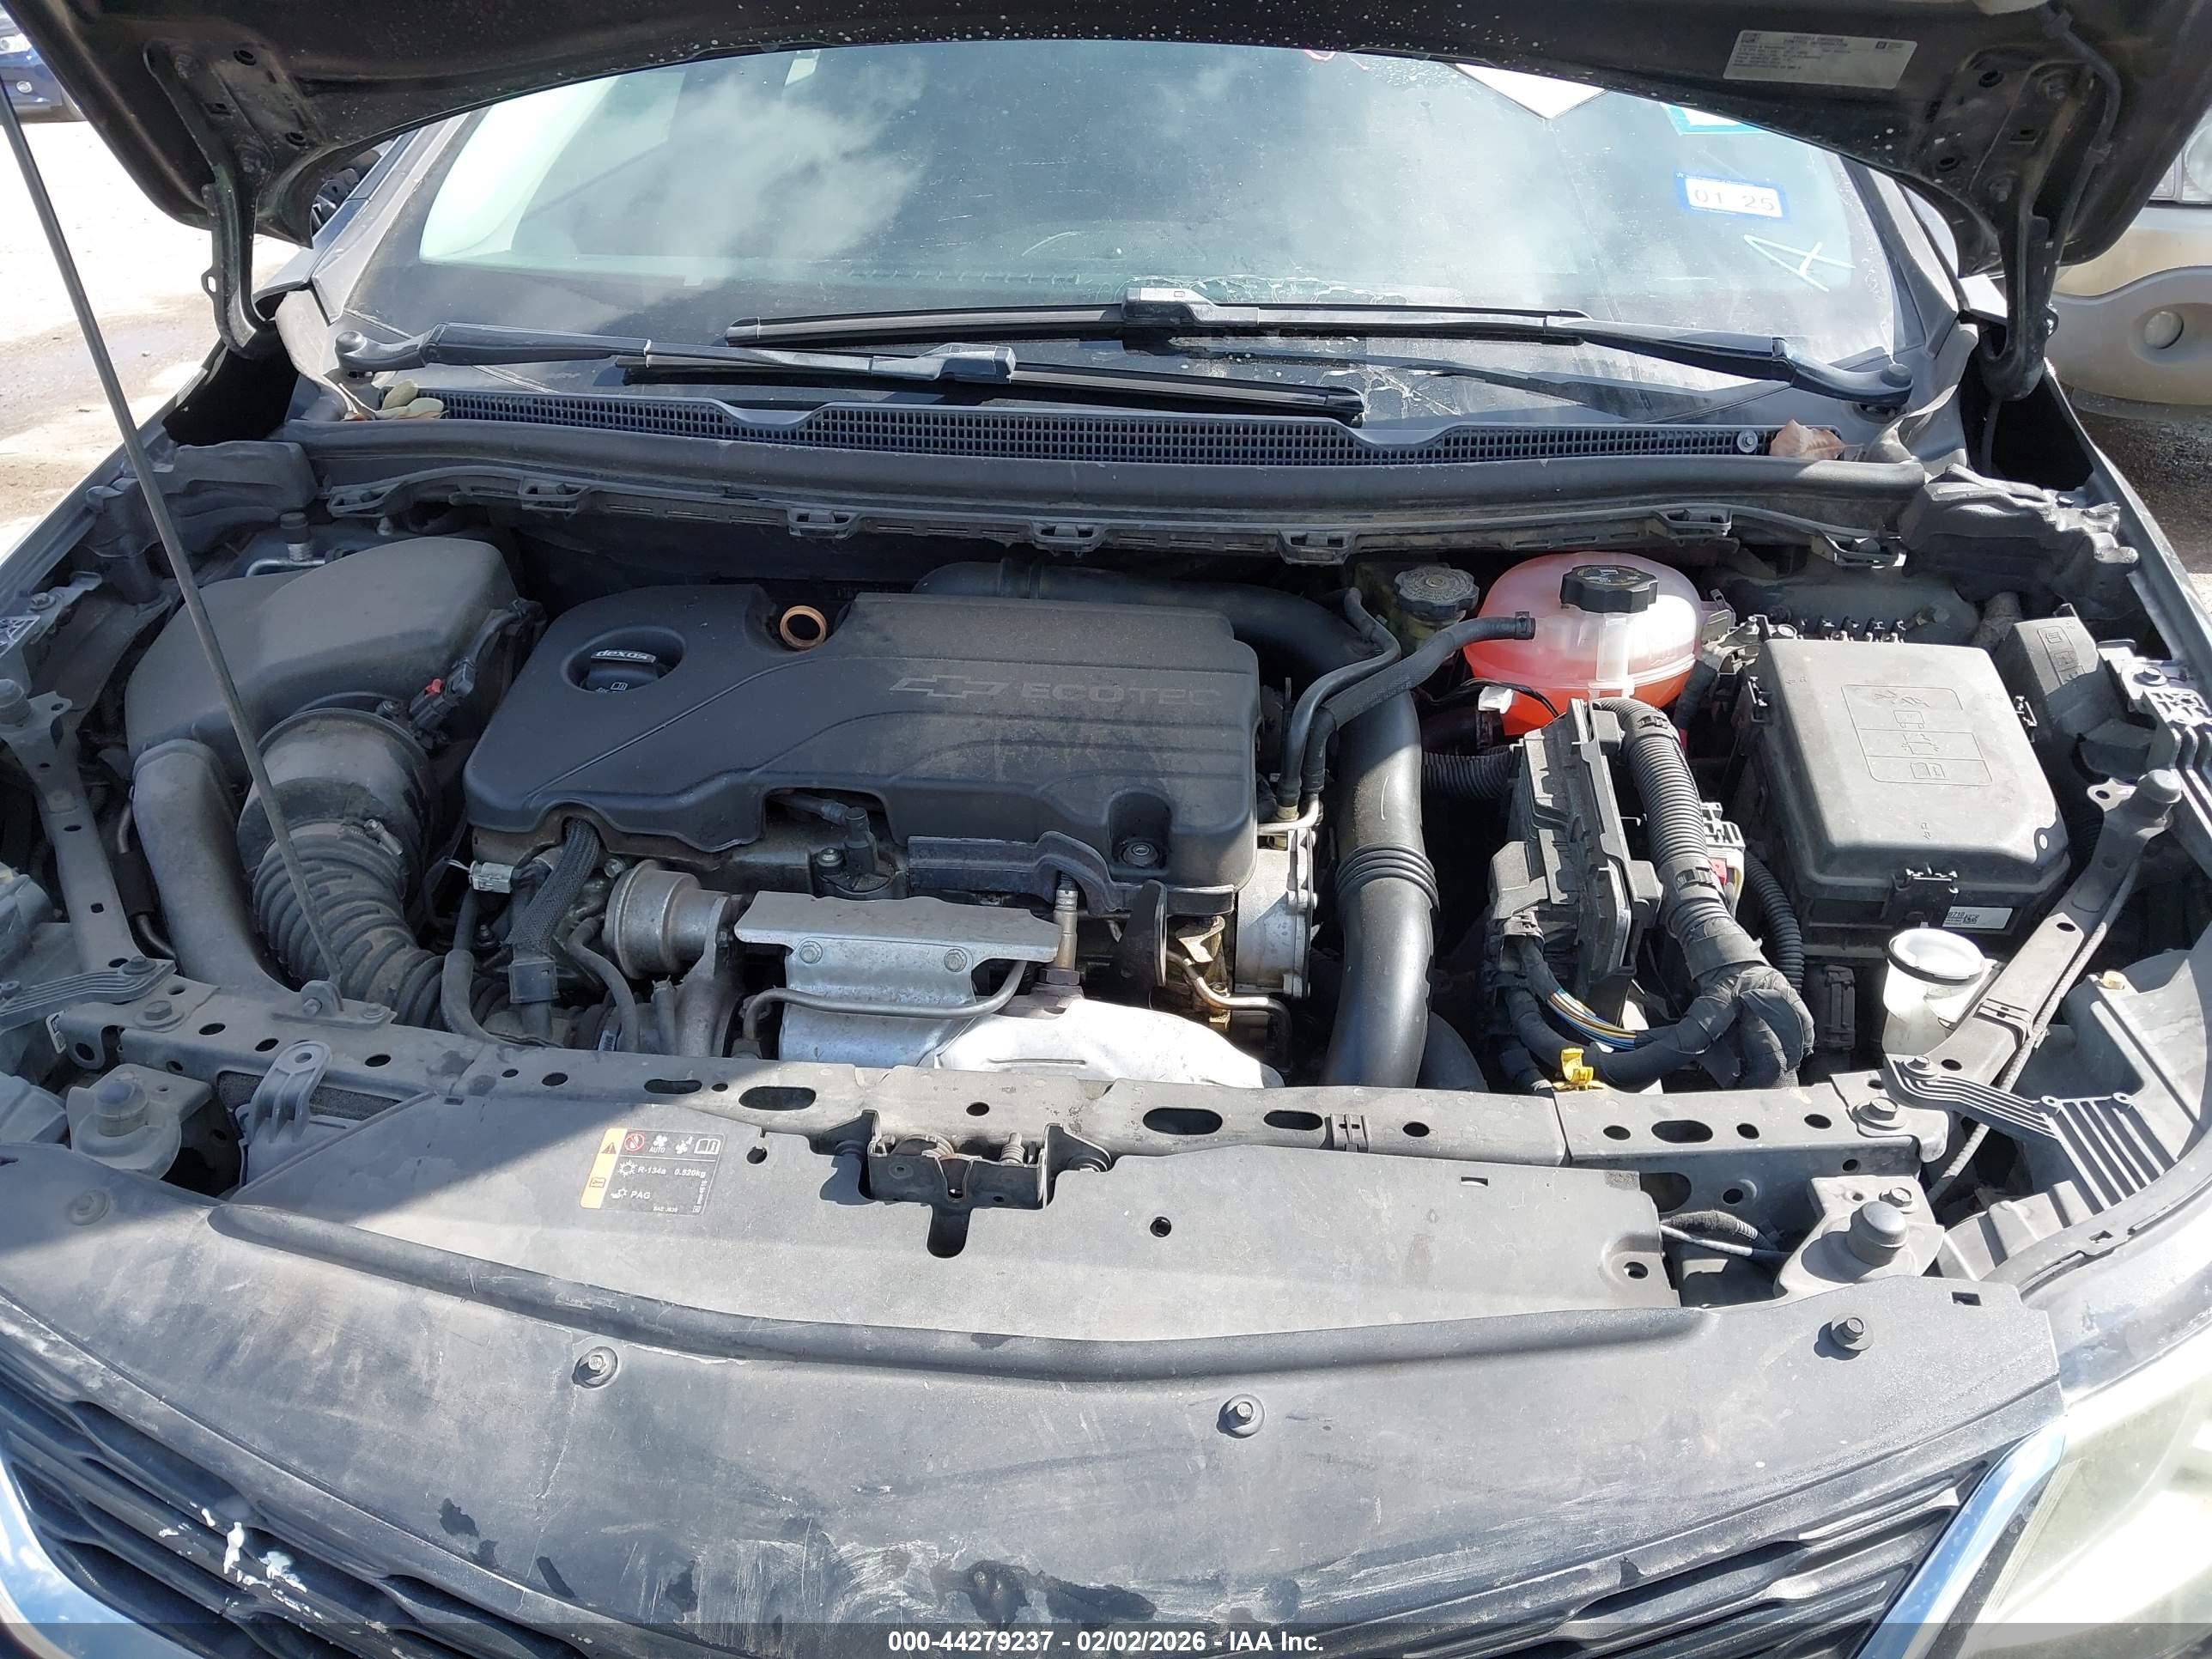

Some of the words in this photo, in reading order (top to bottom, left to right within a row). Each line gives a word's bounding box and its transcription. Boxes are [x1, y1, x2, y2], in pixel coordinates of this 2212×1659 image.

[1694, 188, 1723, 204] 01
[1741, 194, 1775, 211] 25
[1018, 682, 1220, 706] ECOTEC
[637, 1165, 666, 1175] R-134a
[674, 1167, 707, 1177] 0.520kg
[629, 1190, 651, 1200] PAG
